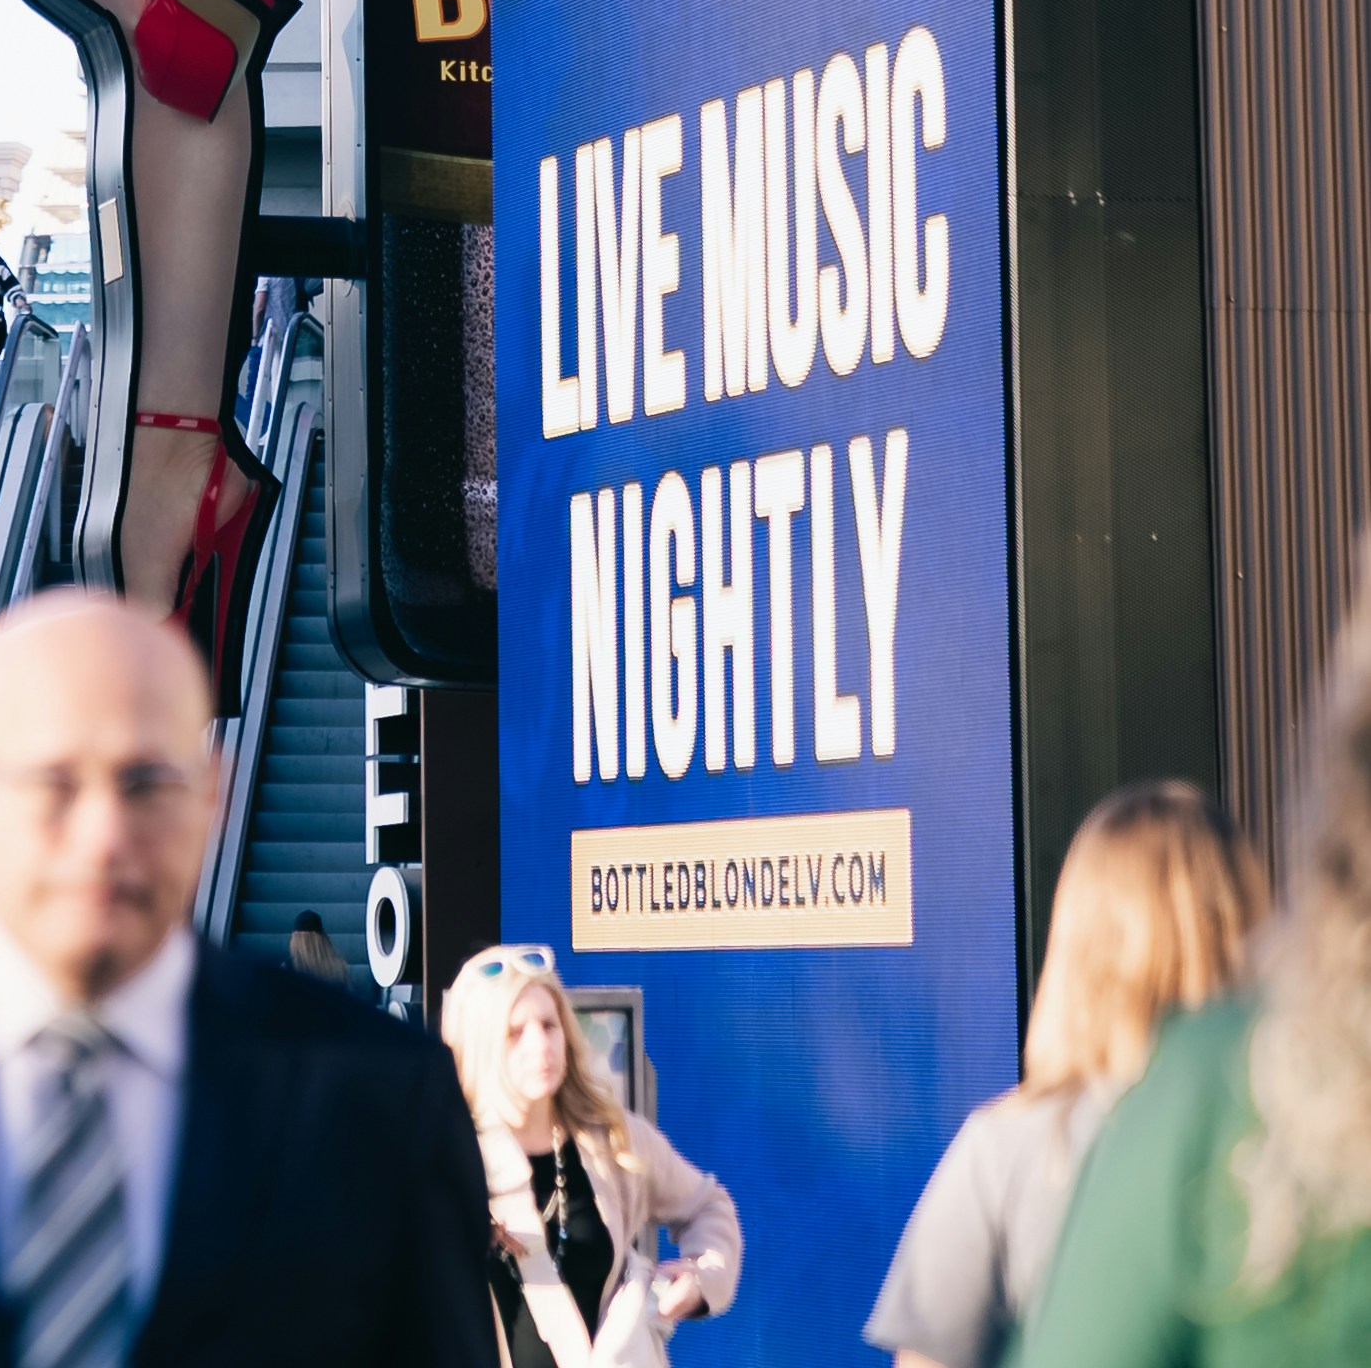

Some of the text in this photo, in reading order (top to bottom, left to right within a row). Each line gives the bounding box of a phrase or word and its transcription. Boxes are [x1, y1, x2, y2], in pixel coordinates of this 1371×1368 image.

[539, 25, 950, 439] LIVE MUSIC
[570, 427, 909, 785] NIGHTLY
[590, 850, 887, 914] BOTTLEDBLONDELV.COM
